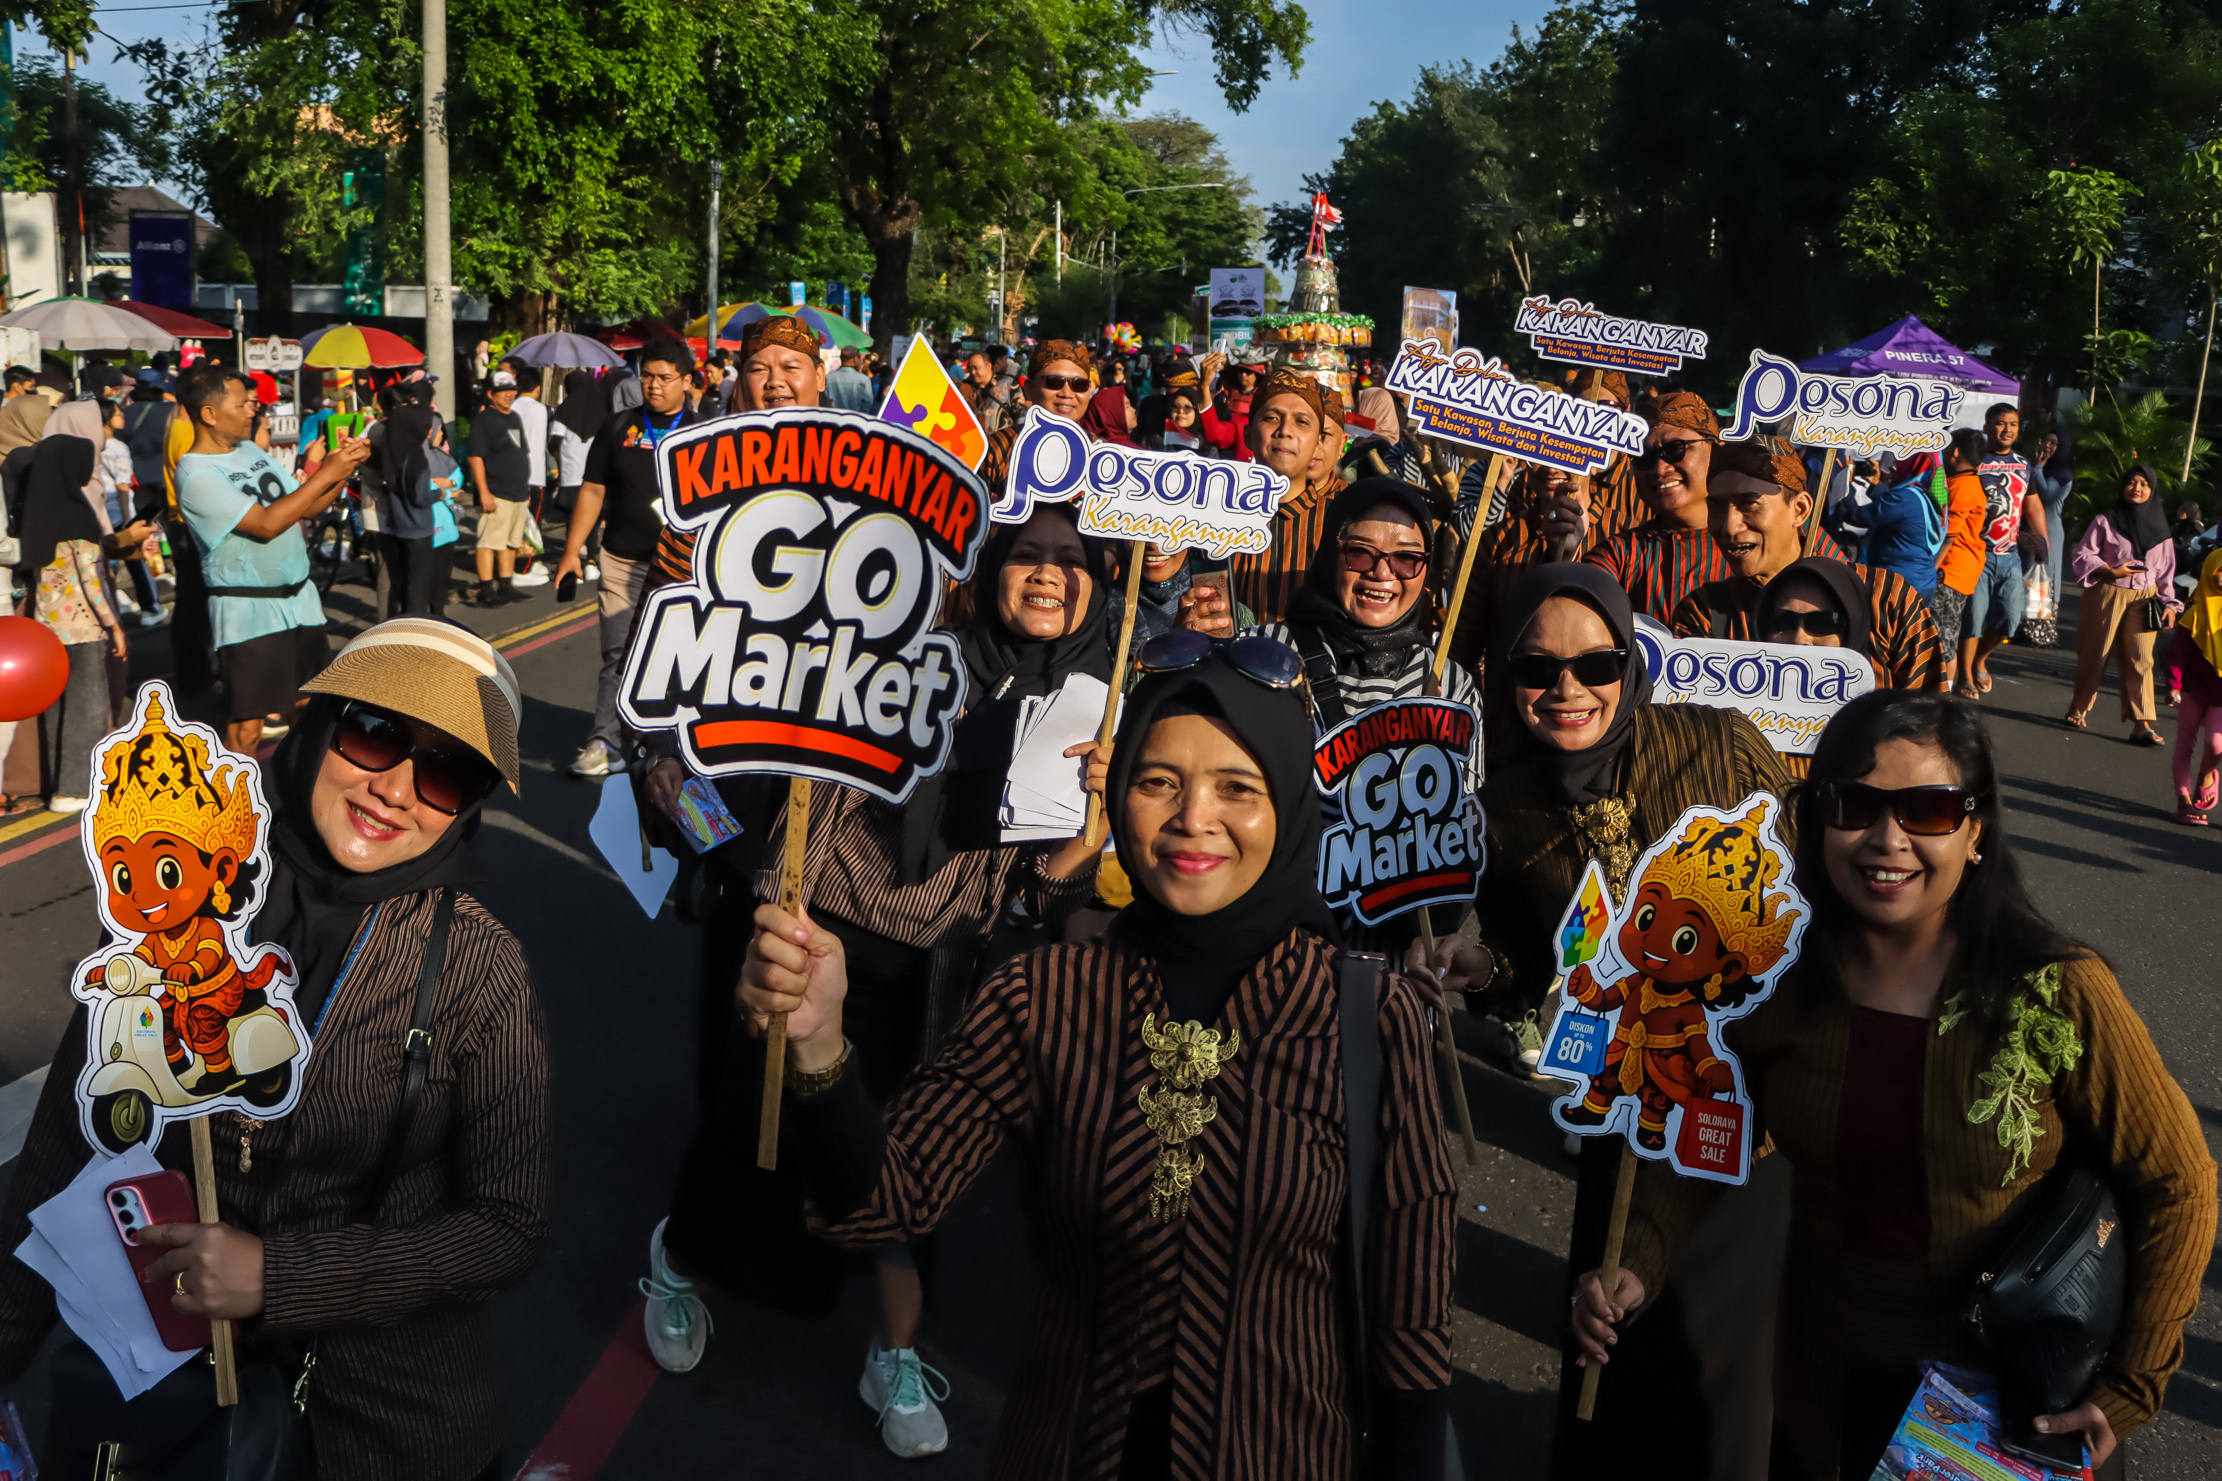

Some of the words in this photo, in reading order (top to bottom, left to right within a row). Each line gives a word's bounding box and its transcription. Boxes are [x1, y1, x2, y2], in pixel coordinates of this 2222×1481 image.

[827, 282, 838, 296] P
[1523, 296, 1557, 317] Ayo
[1558, 300, 1602, 319] Dolan
[1519, 307, 1707, 356] KARANGANYAR
[1535, 335, 1553, 346] Satu
[1555, 338, 1594, 353] Kawasan,
[1596, 345, 1626, 357] Berjuta
[1627, 349, 1679, 364] Kesempatan
[1401, 342, 1449, 371] Ayo
[1453, 351, 1512, 382] Dolan
[1547, 345, 1579, 359] Belanja,
[1581, 350, 1609, 363] Wisata
[1610, 354, 1626, 364] dan
[1628, 354, 1664, 370] Investasi
[1884, 350, 1947, 364] PINERA
[1948, 354, 1965, 366] 57
[1392, 356, 1646, 451] KARANGANYAR
[1724, 351, 1962, 440] Pesona
[1415, 399, 1441, 415] Satu
[1443, 406, 1495, 431] Kawasan,
[1498, 421, 1538, 441] Berjuta
[1539, 433, 1605, 460] Kesempatan
[1429, 415, 1473, 437] Belanja,
[1477, 427, 1514, 447] Wisata
[1515, 438, 1536, 453] dan
[1538, 442, 1586, 466] Investasi
[1795, 416, 1946, 455] Karanganyar
[995, 411, 1288, 516] Pesona
[674, 427, 978, 555] KARANGANYAR
[1084, 497, 1265, 555] Karanganyar
[714, 488, 924, 640] GO
[636, 602, 952, 749] Market
[1314, 706, 1472, 784] KARANGANYAR
[1349, 743, 1452, 832] GO
[1325, 803, 1479, 895] Market
[1569, 1020, 1596, 1035] DISKON
[1697, 1112, 1737, 1131] SOLORAYA
[1698, 1127, 1733, 1147] GREAT
[1700, 1144, 1727, 1164] SALE
